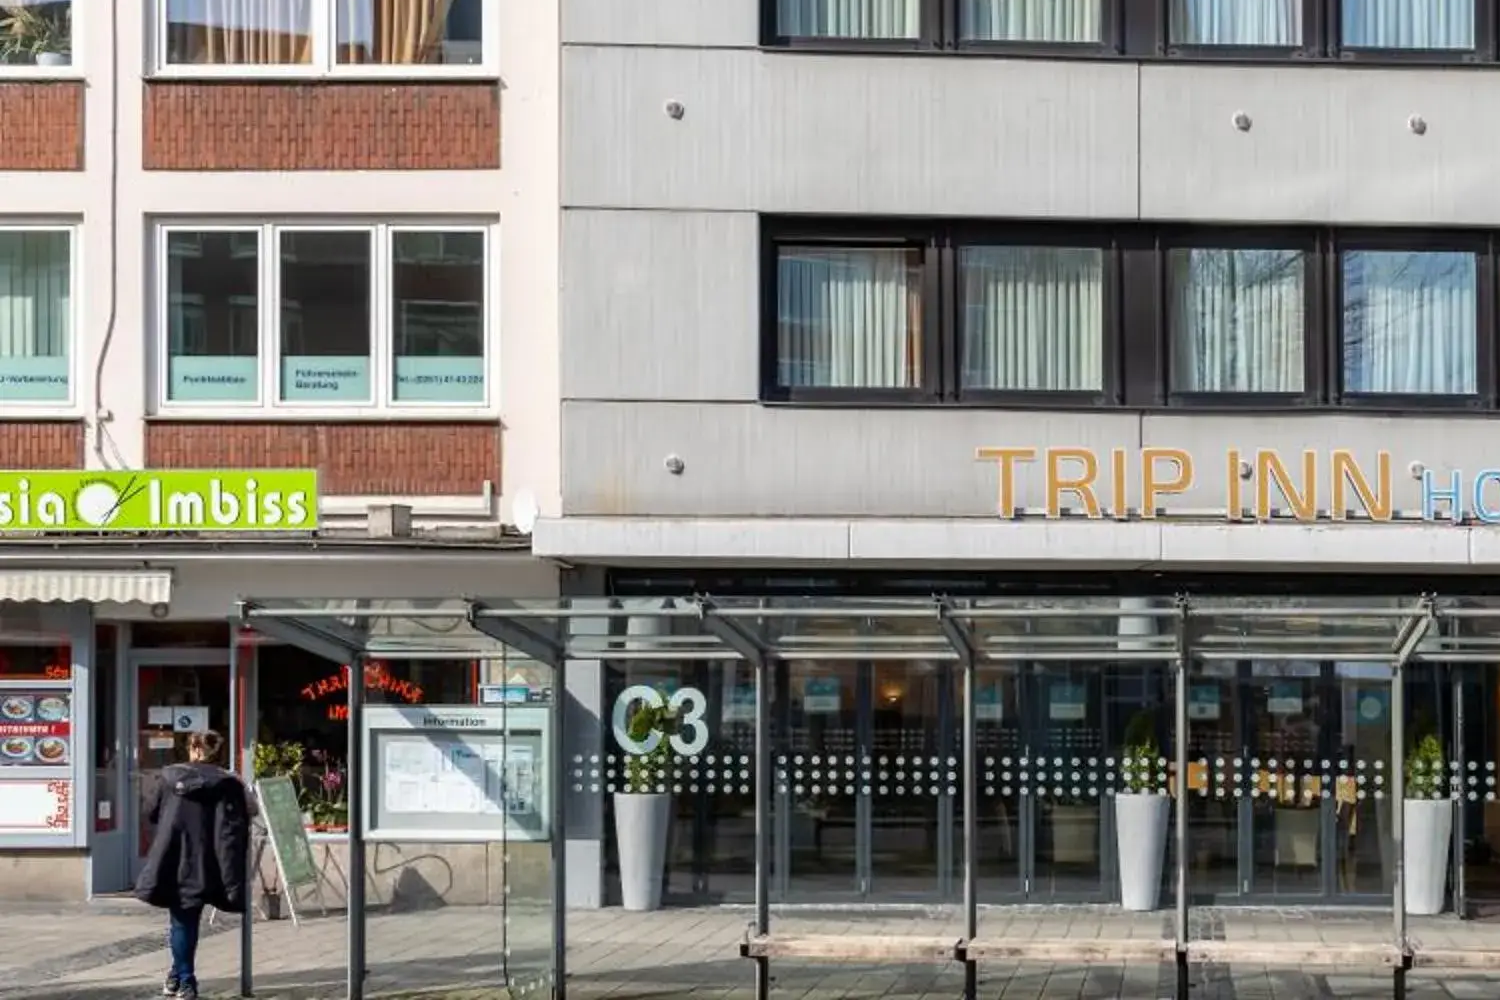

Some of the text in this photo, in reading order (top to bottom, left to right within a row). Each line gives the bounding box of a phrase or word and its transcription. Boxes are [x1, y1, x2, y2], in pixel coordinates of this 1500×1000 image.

[149, 477, 308, 526] Imbiss
[975, 446, 1195, 519] TRIP
[1226, 447, 1392, 521] INN
[423, 716, 488, 728] Information
